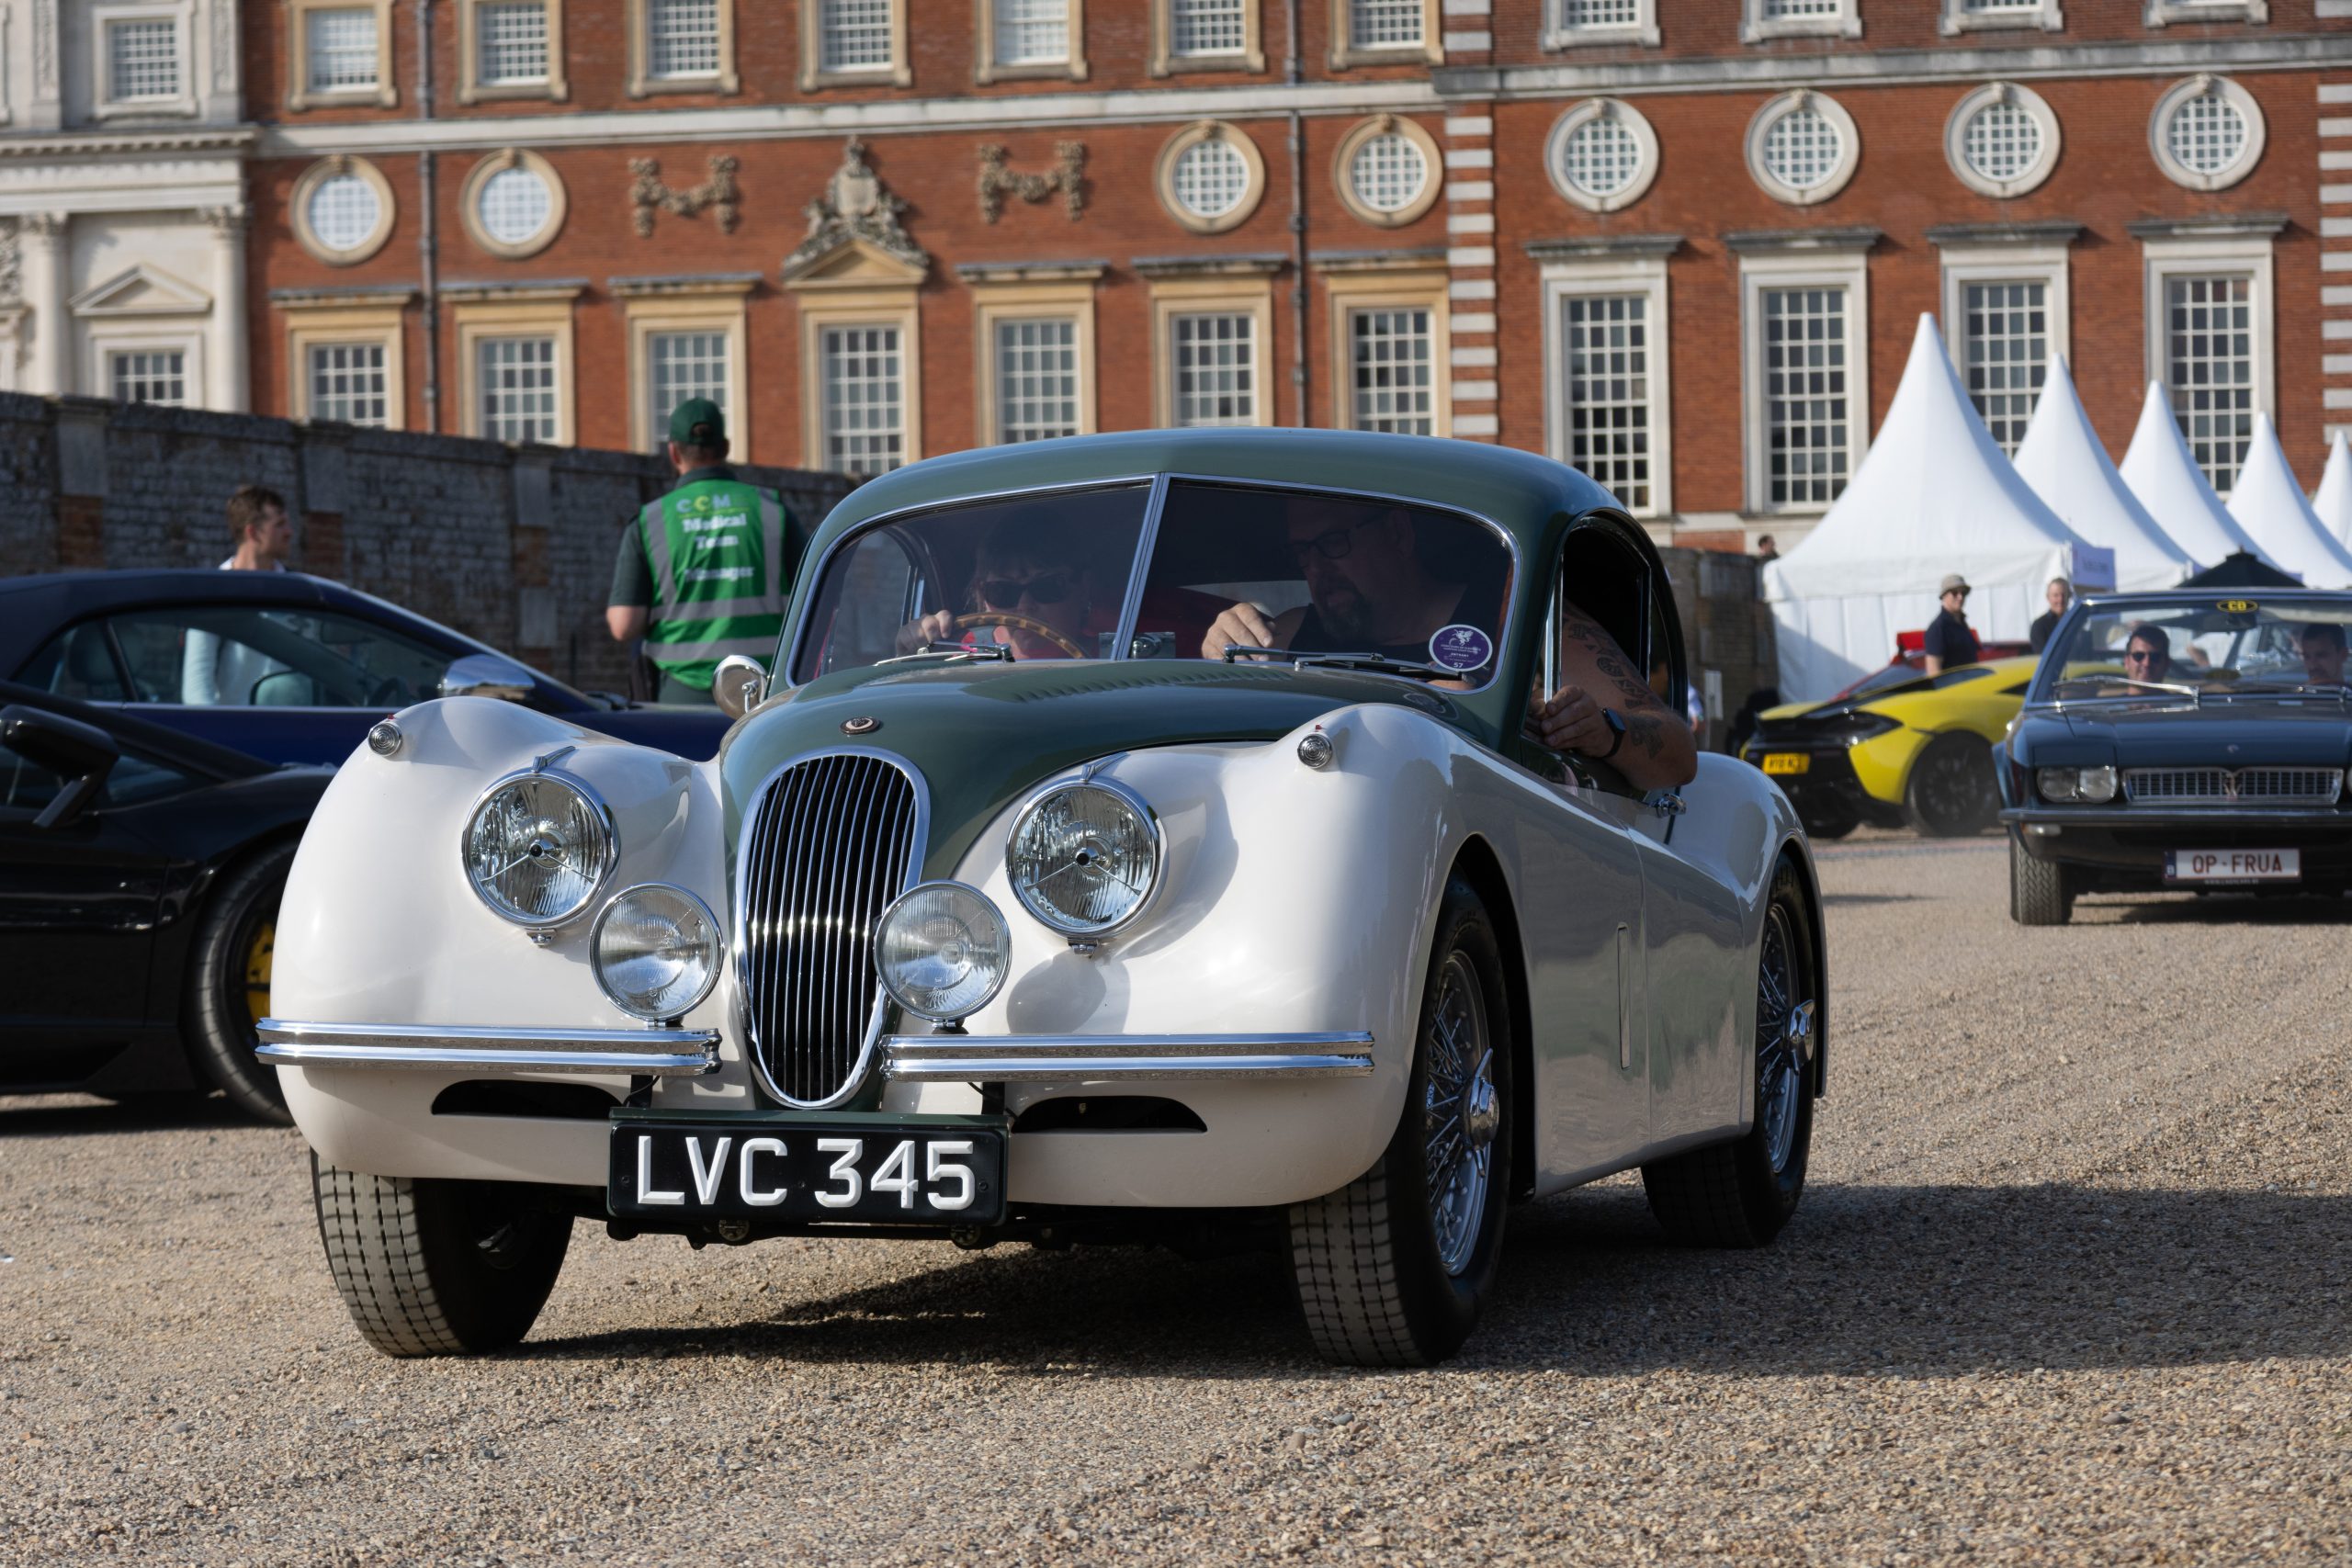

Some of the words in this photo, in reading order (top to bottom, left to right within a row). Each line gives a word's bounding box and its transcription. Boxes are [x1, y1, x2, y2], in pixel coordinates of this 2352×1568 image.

[676, 493, 732, 513] CCM
[683, 513, 747, 533] Medical
[695, 535, 739, 550] Team
[638, 1135, 788, 1206] LVC
[814, 1138, 976, 1211] 345
